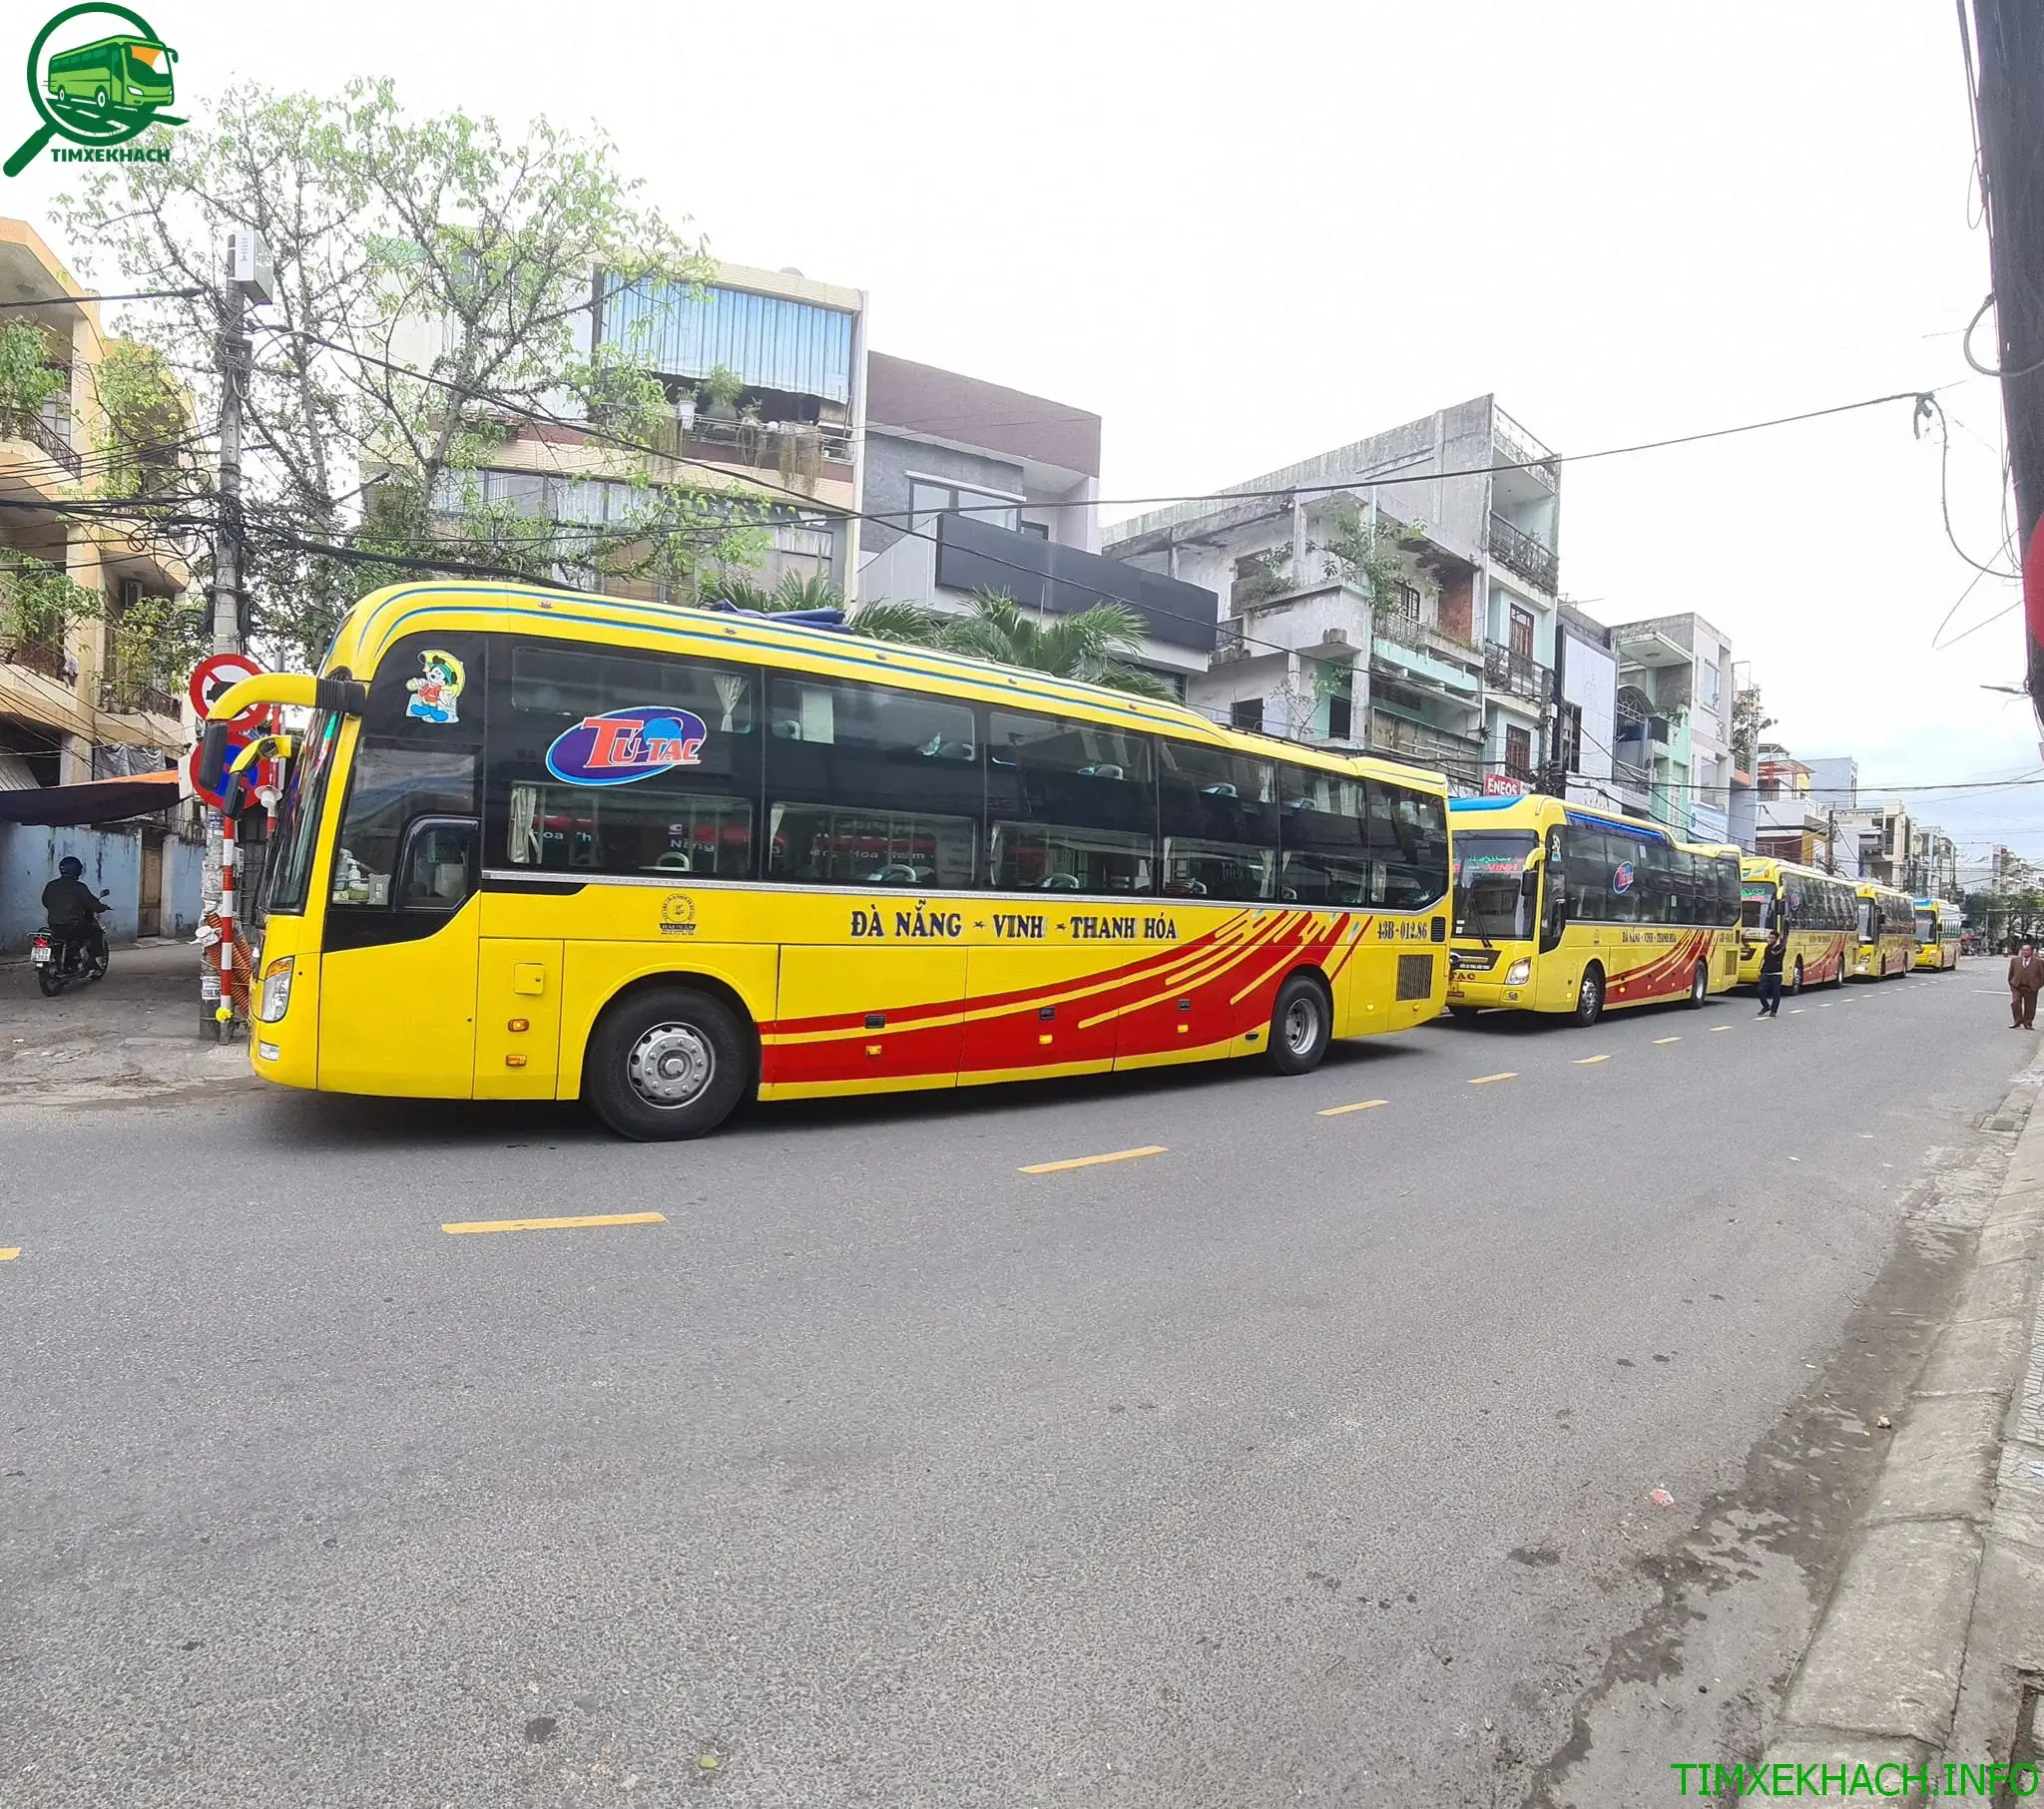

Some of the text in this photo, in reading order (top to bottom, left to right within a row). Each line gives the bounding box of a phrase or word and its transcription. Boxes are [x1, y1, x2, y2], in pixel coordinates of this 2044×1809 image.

[1487, 778, 1518, 796] ENEOS
[850, 899, 1178, 939] ĐÀ NẴNG VINH THANH HÓA
